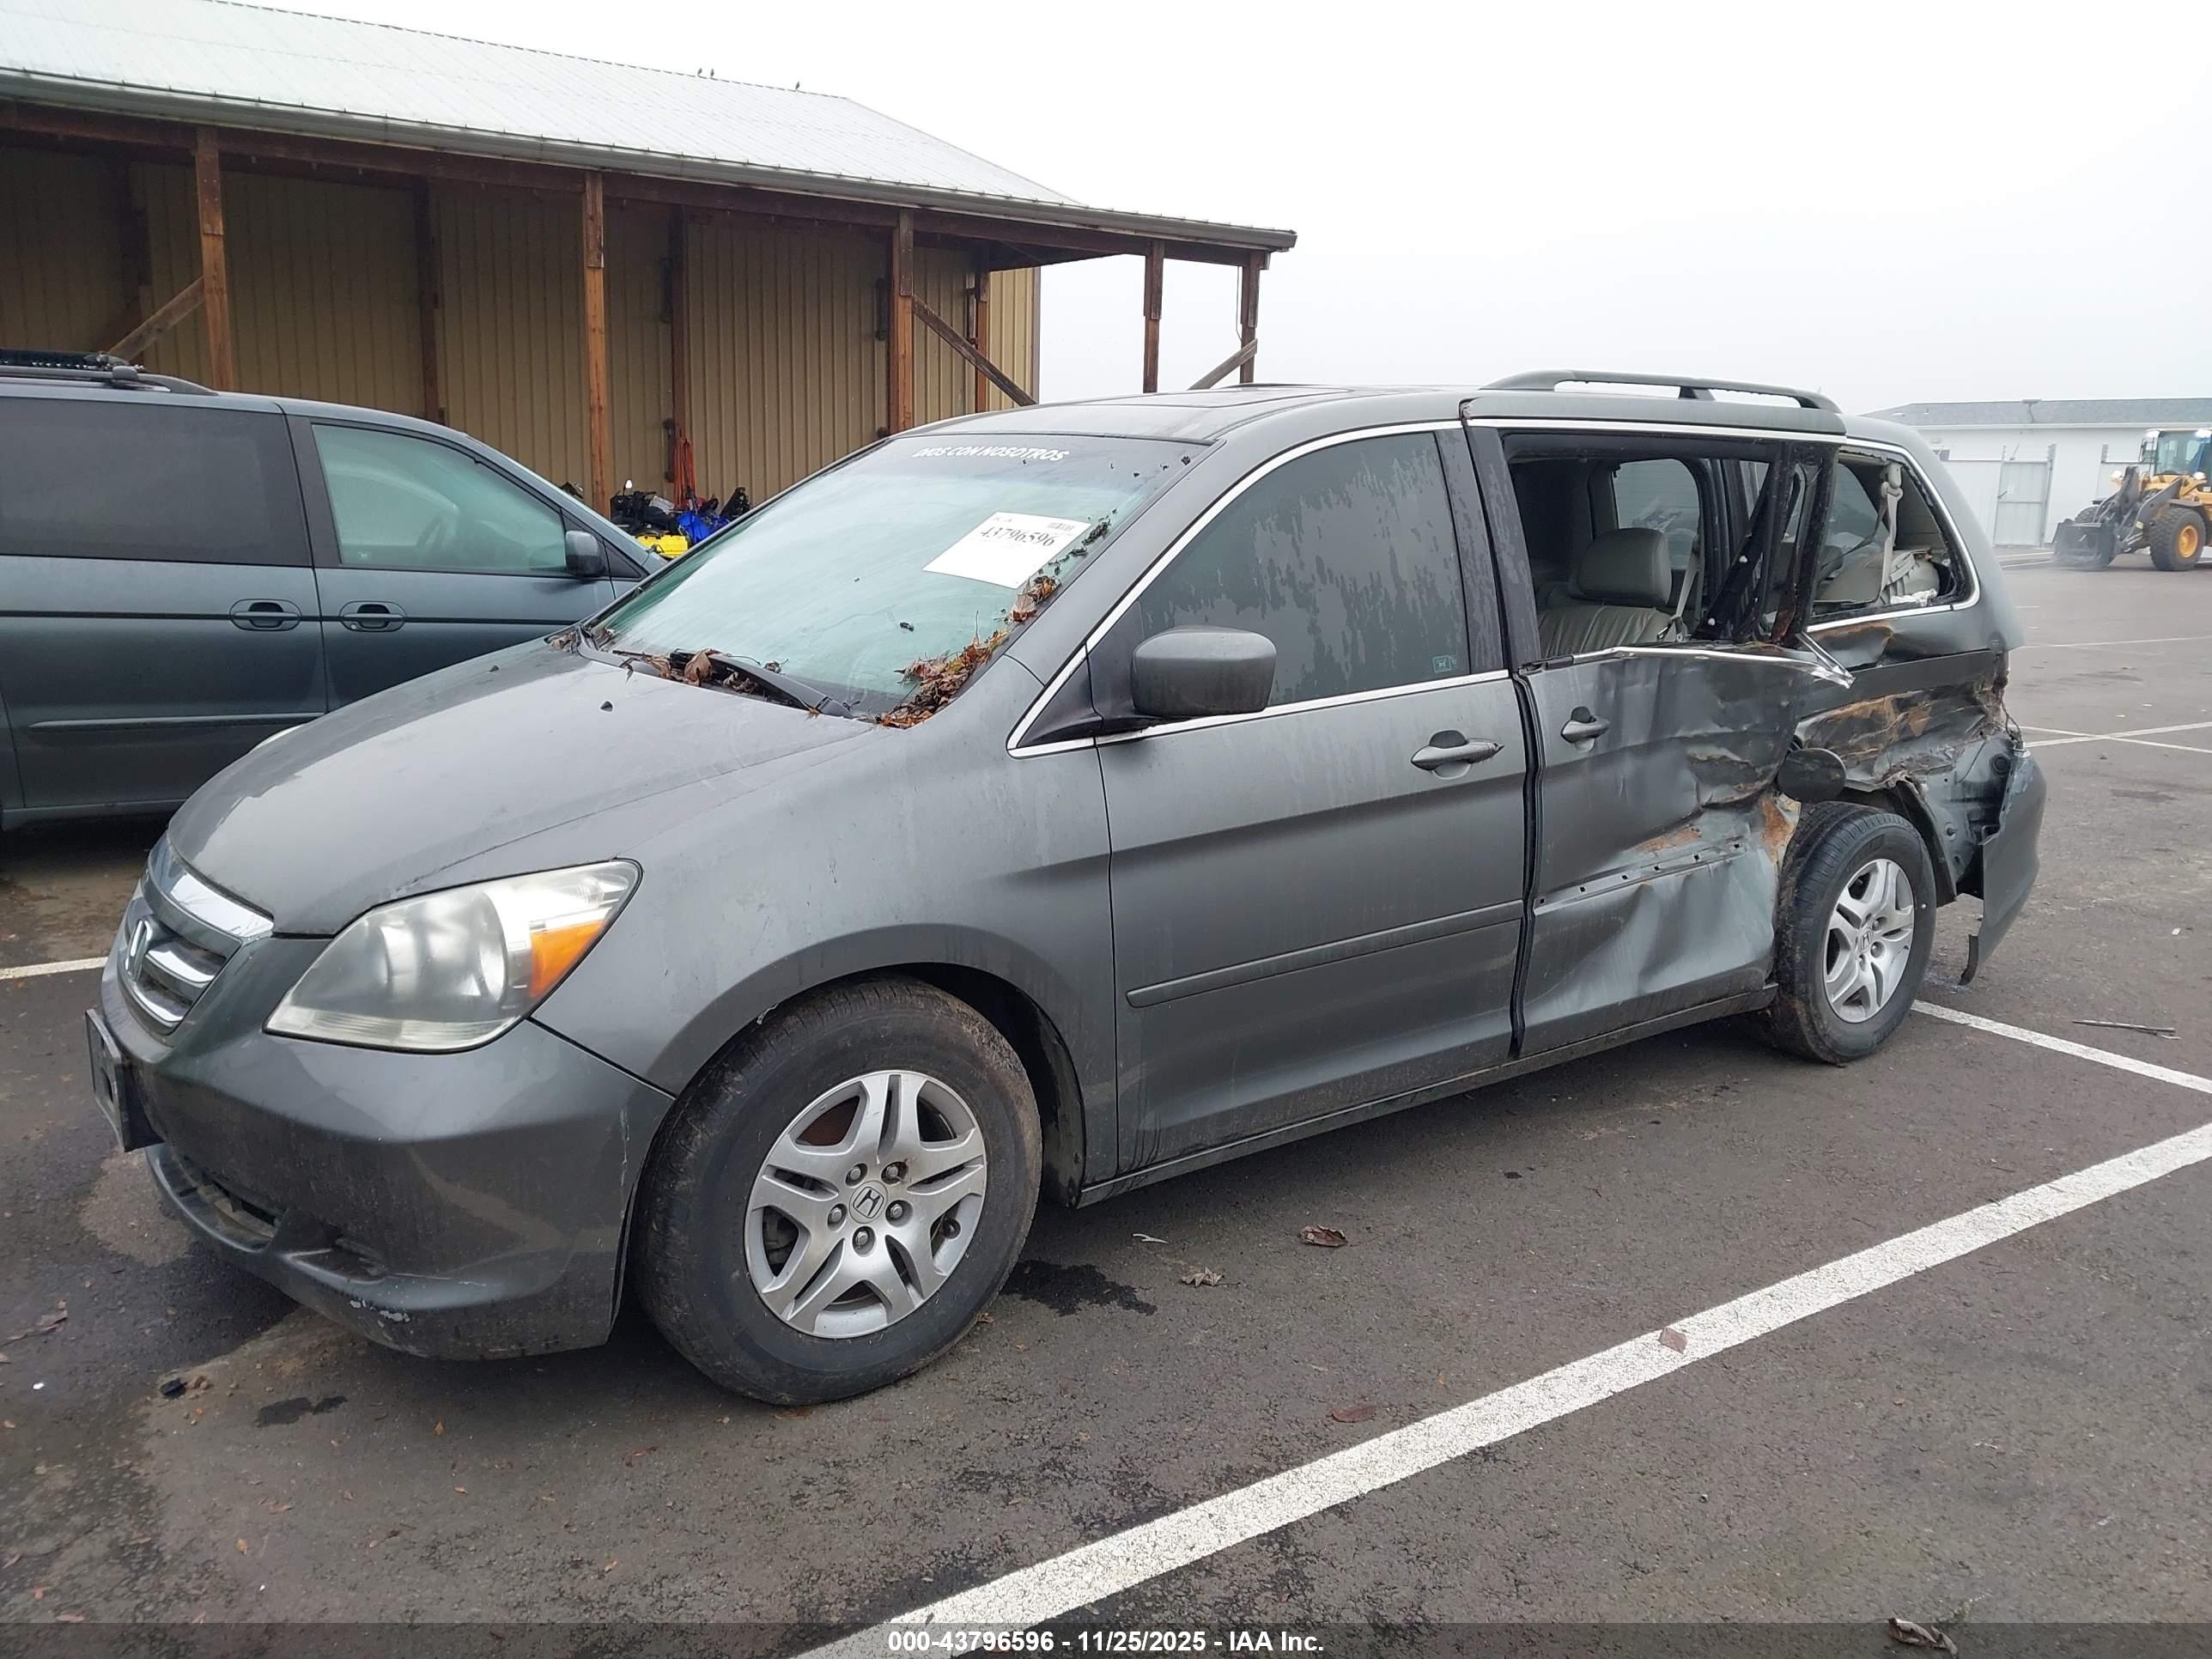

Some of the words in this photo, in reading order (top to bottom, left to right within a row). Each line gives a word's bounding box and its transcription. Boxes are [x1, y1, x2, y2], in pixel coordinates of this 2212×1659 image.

[946, 446, 985, 457] CON
[977, 446, 1070, 461] NOSOTROS
[980, 526, 1058, 547] 43796596
